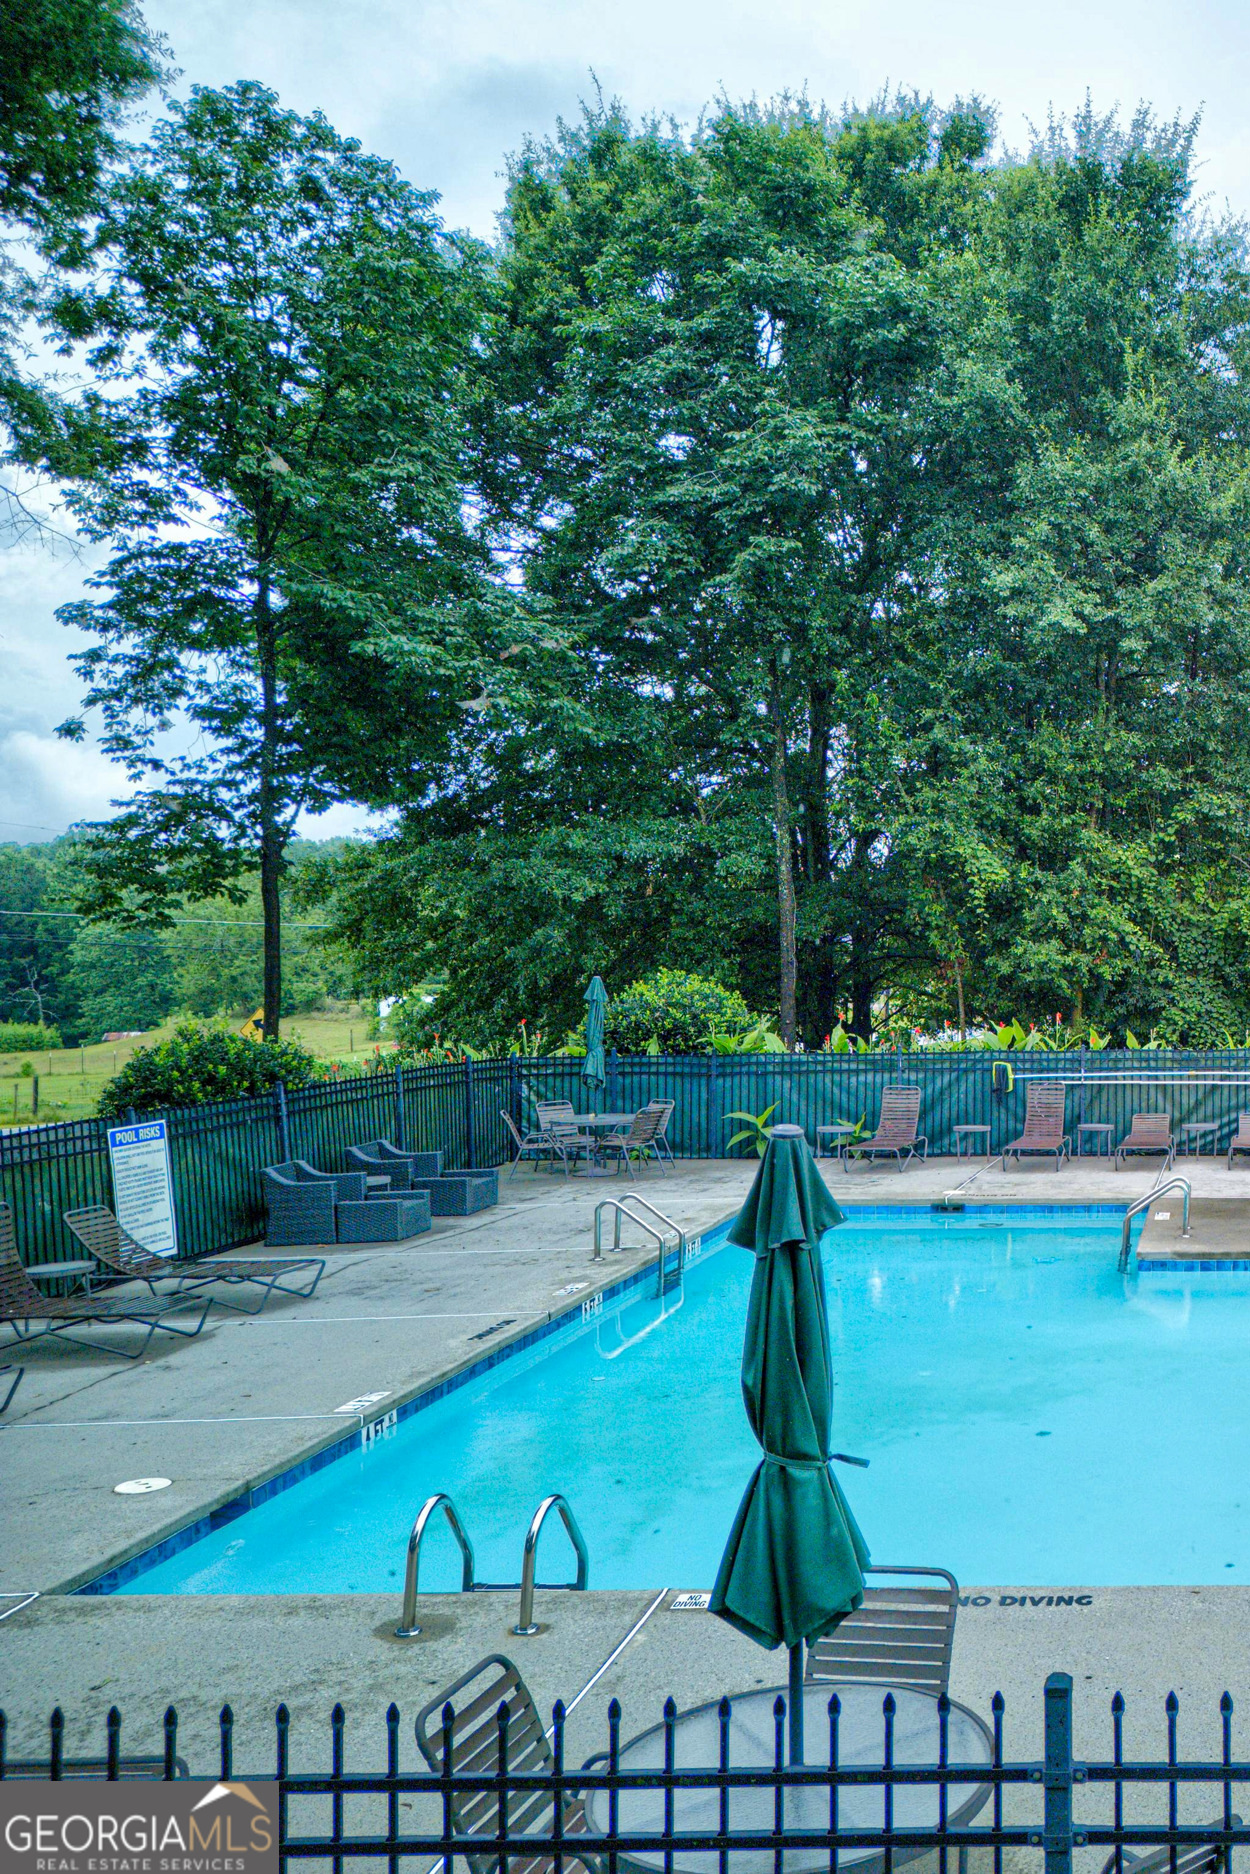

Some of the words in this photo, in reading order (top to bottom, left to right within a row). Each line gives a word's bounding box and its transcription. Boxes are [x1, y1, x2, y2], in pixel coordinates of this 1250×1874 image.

[115, 1131, 137, 1145] POOL
[138, 1126, 161, 1141] RISKS
[365, 1426, 371, 1442] 4
[374, 1417, 385, 1438] FT
[673, 1600, 707, 1608] DIVING
[687, 1594, 703, 1602] NO
[957, 1595, 992, 1607] NO
[998, 1595, 1093, 1607] DIVING
